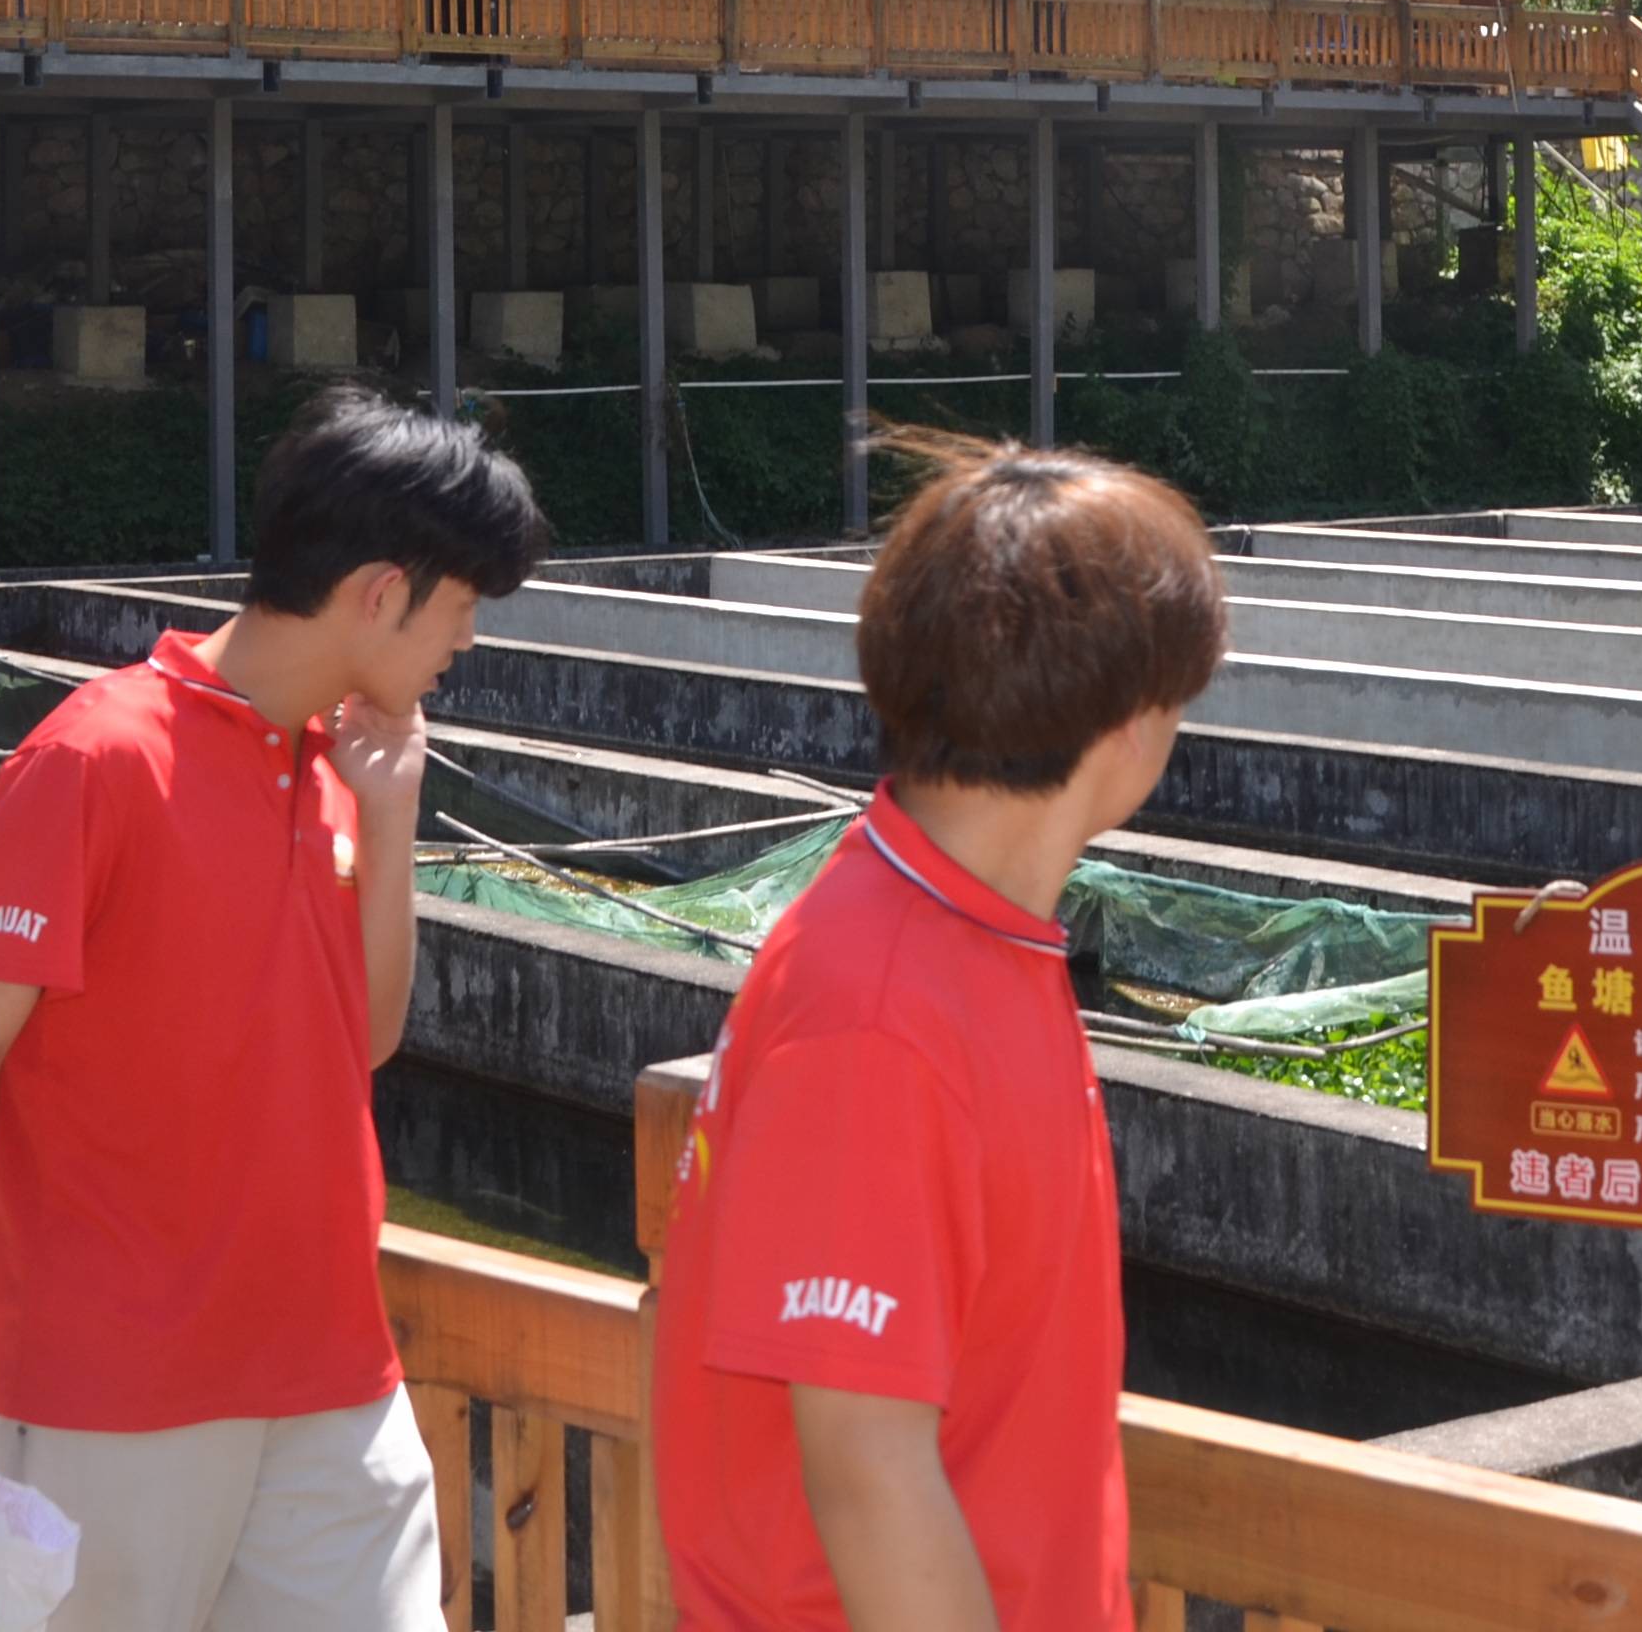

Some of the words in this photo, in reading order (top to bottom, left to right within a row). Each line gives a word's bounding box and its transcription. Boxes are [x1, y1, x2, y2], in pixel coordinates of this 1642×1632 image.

[1539, 1107, 1612, 1133] 当心落水
[779, 1276, 899, 1337] XAUAT
